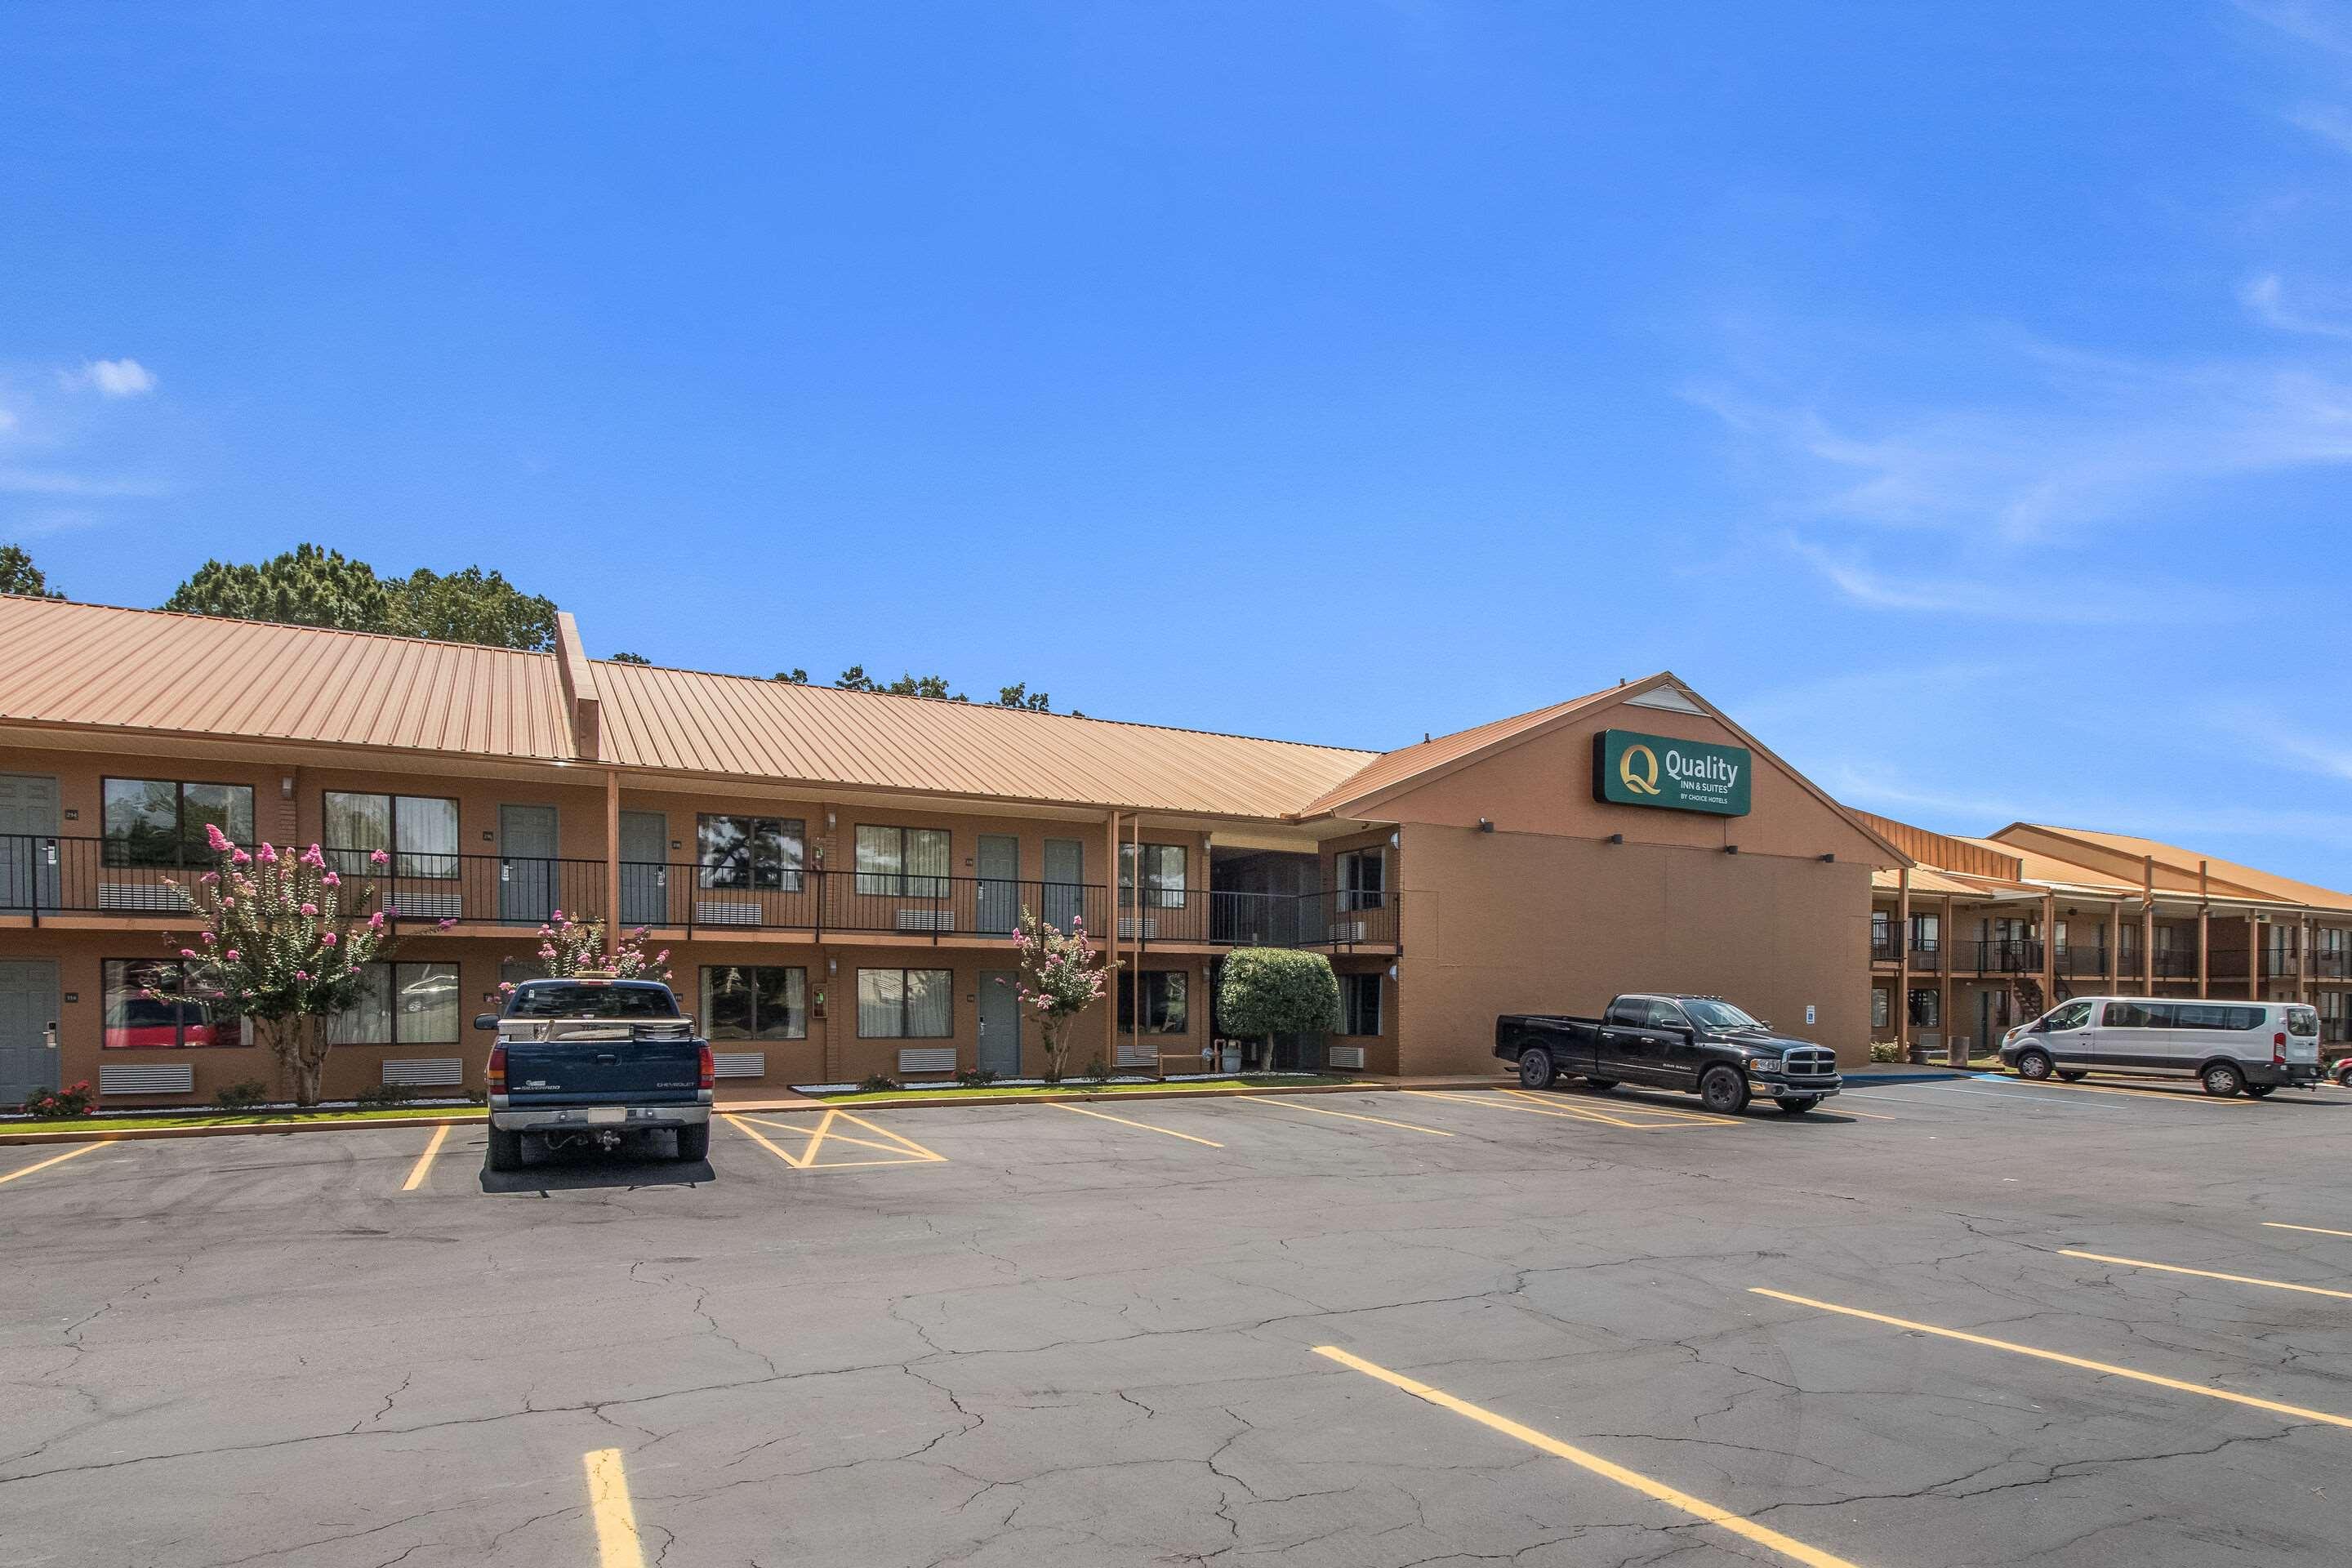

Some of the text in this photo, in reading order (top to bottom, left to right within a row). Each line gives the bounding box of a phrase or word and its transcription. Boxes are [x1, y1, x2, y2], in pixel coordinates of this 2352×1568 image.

[1665, 750, 1739, 788] Quality
[1681, 780, 1728, 794] INN & SUITES
[1688, 794, 1708, 802] CHOICE
[1708, 795, 1728, 804] HOTELS
